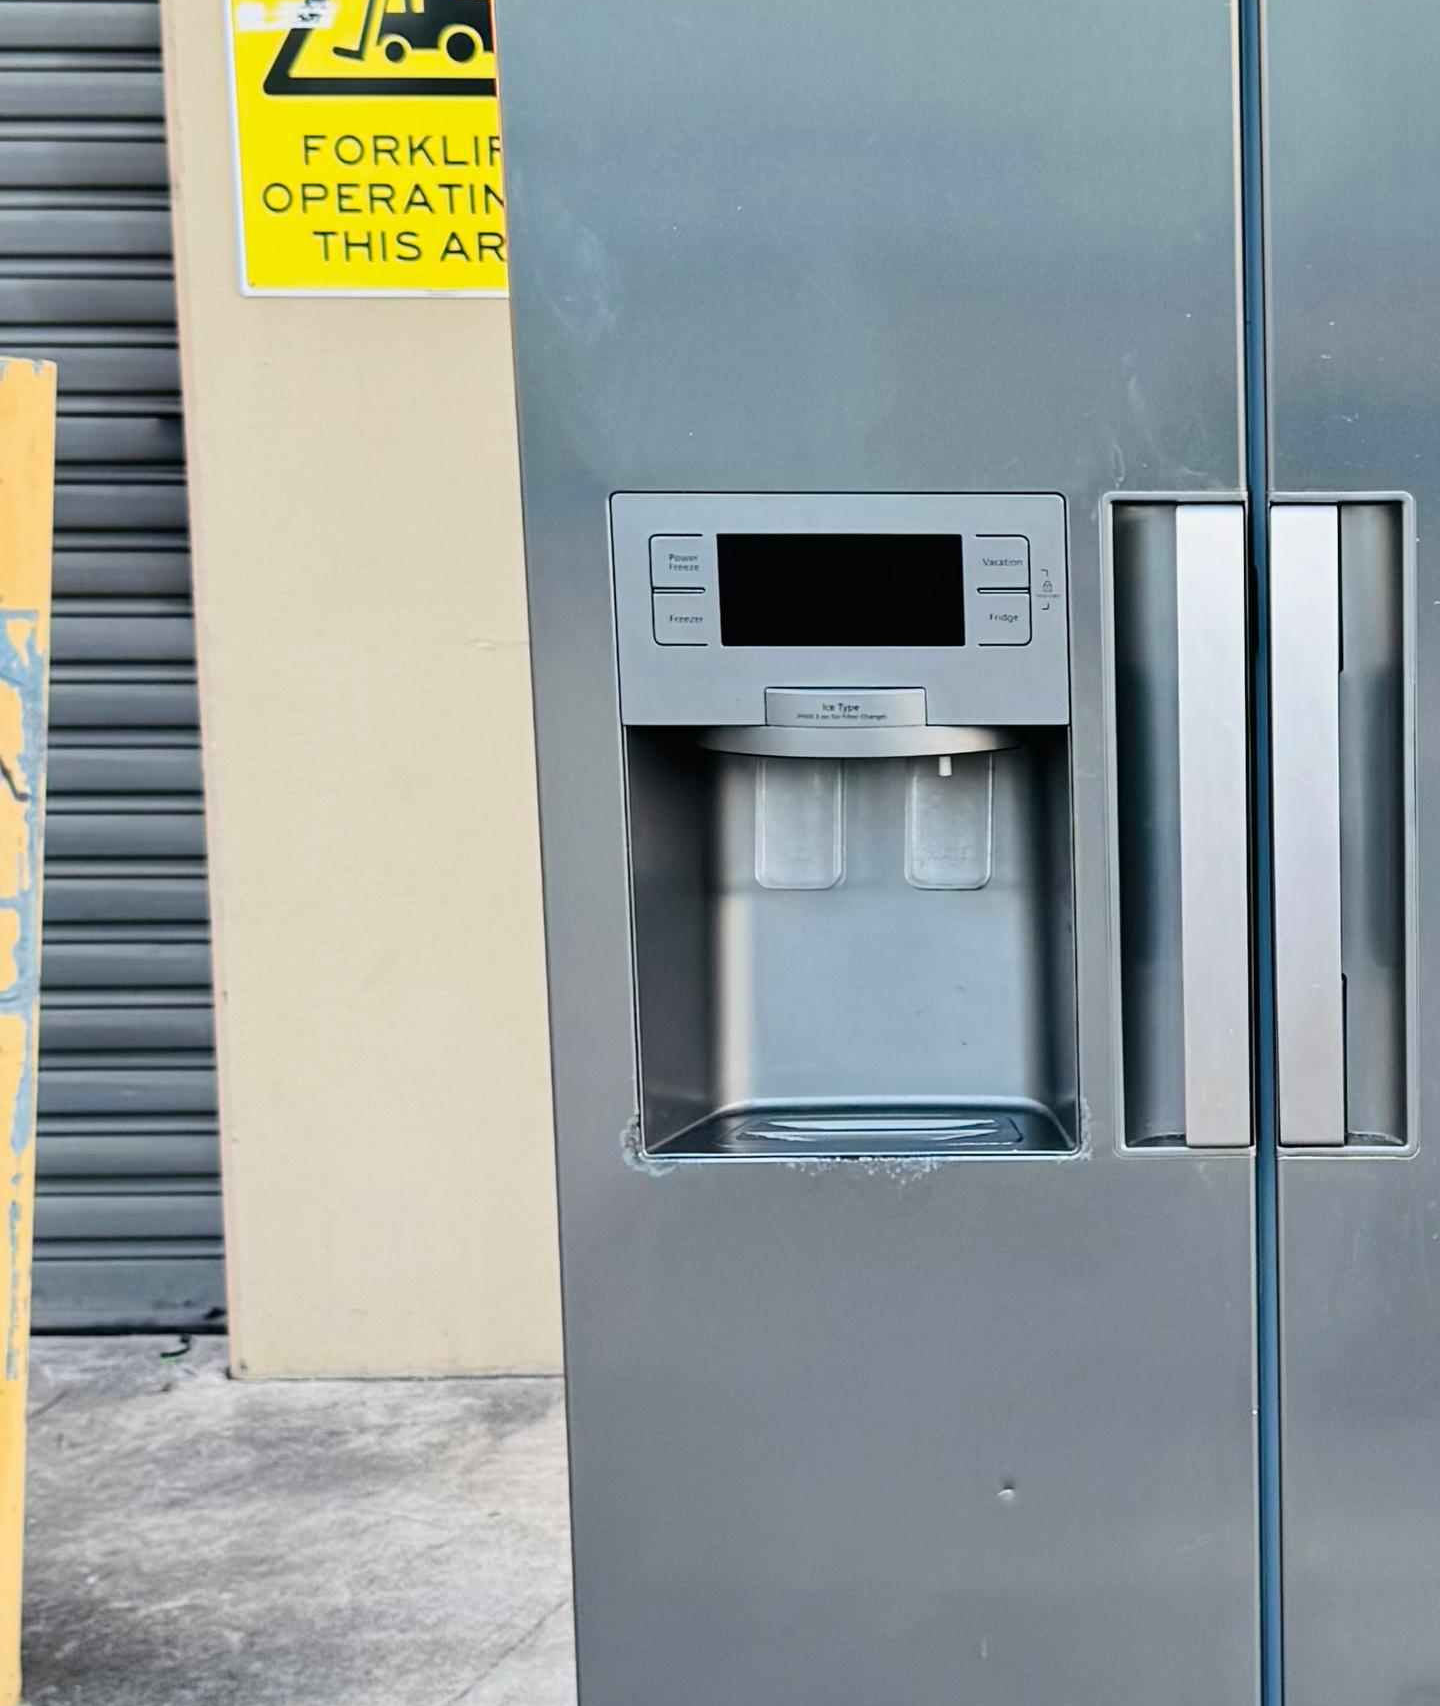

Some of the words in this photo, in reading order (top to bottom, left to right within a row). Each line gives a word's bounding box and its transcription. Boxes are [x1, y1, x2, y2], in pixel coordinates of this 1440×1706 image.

[262, 182, 504, 215] OPERATIN
[312, 231, 423, 262] THIS
[439, 231, 507, 263] AR
